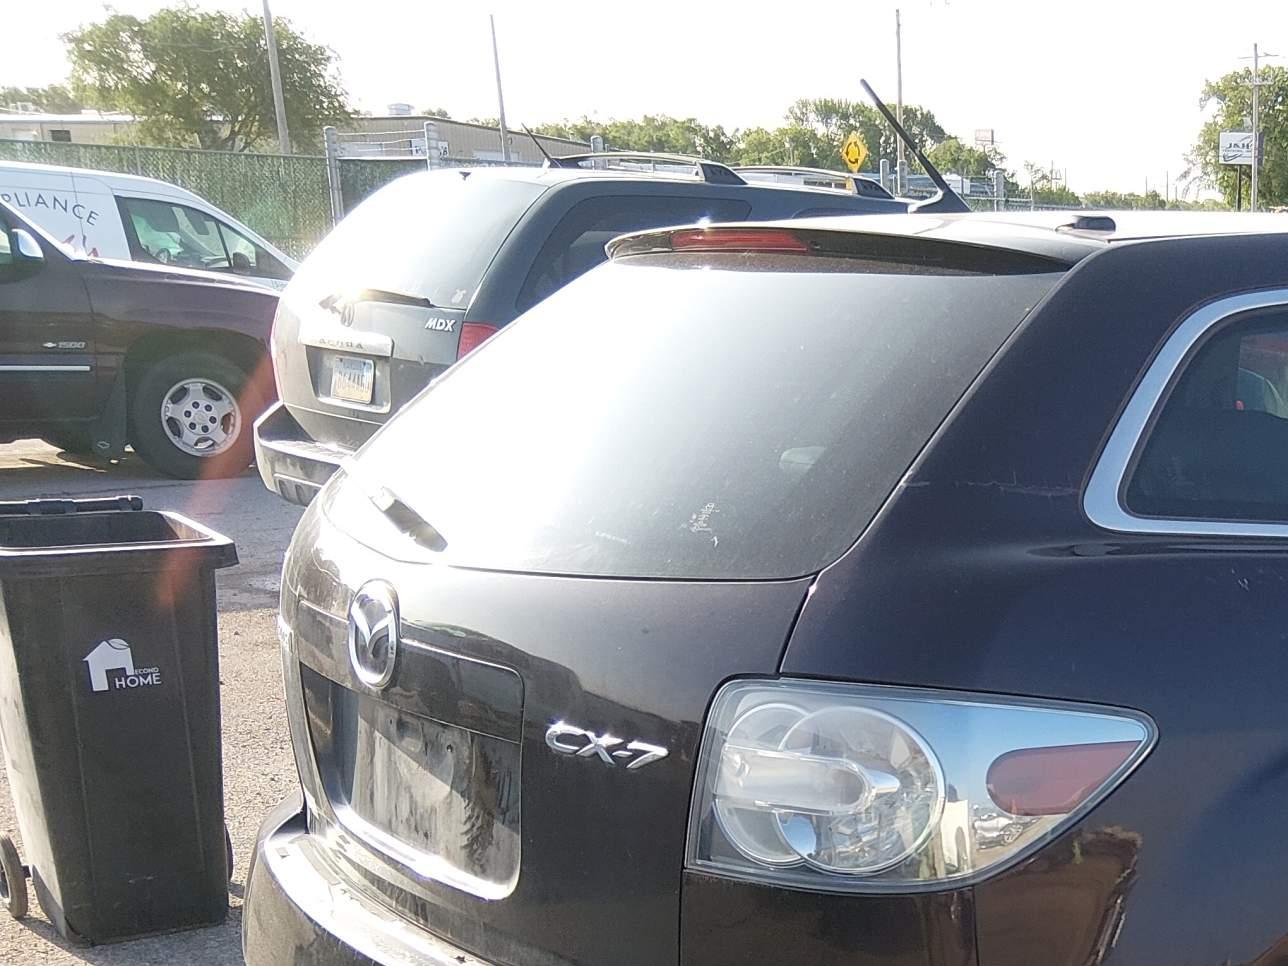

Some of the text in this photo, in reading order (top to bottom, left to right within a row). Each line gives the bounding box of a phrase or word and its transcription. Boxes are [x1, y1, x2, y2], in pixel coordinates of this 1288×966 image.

[424, 317, 456, 332] MDX
[115, 673, 162, 689] HOME
[545, 720, 669, 769] CX-7
